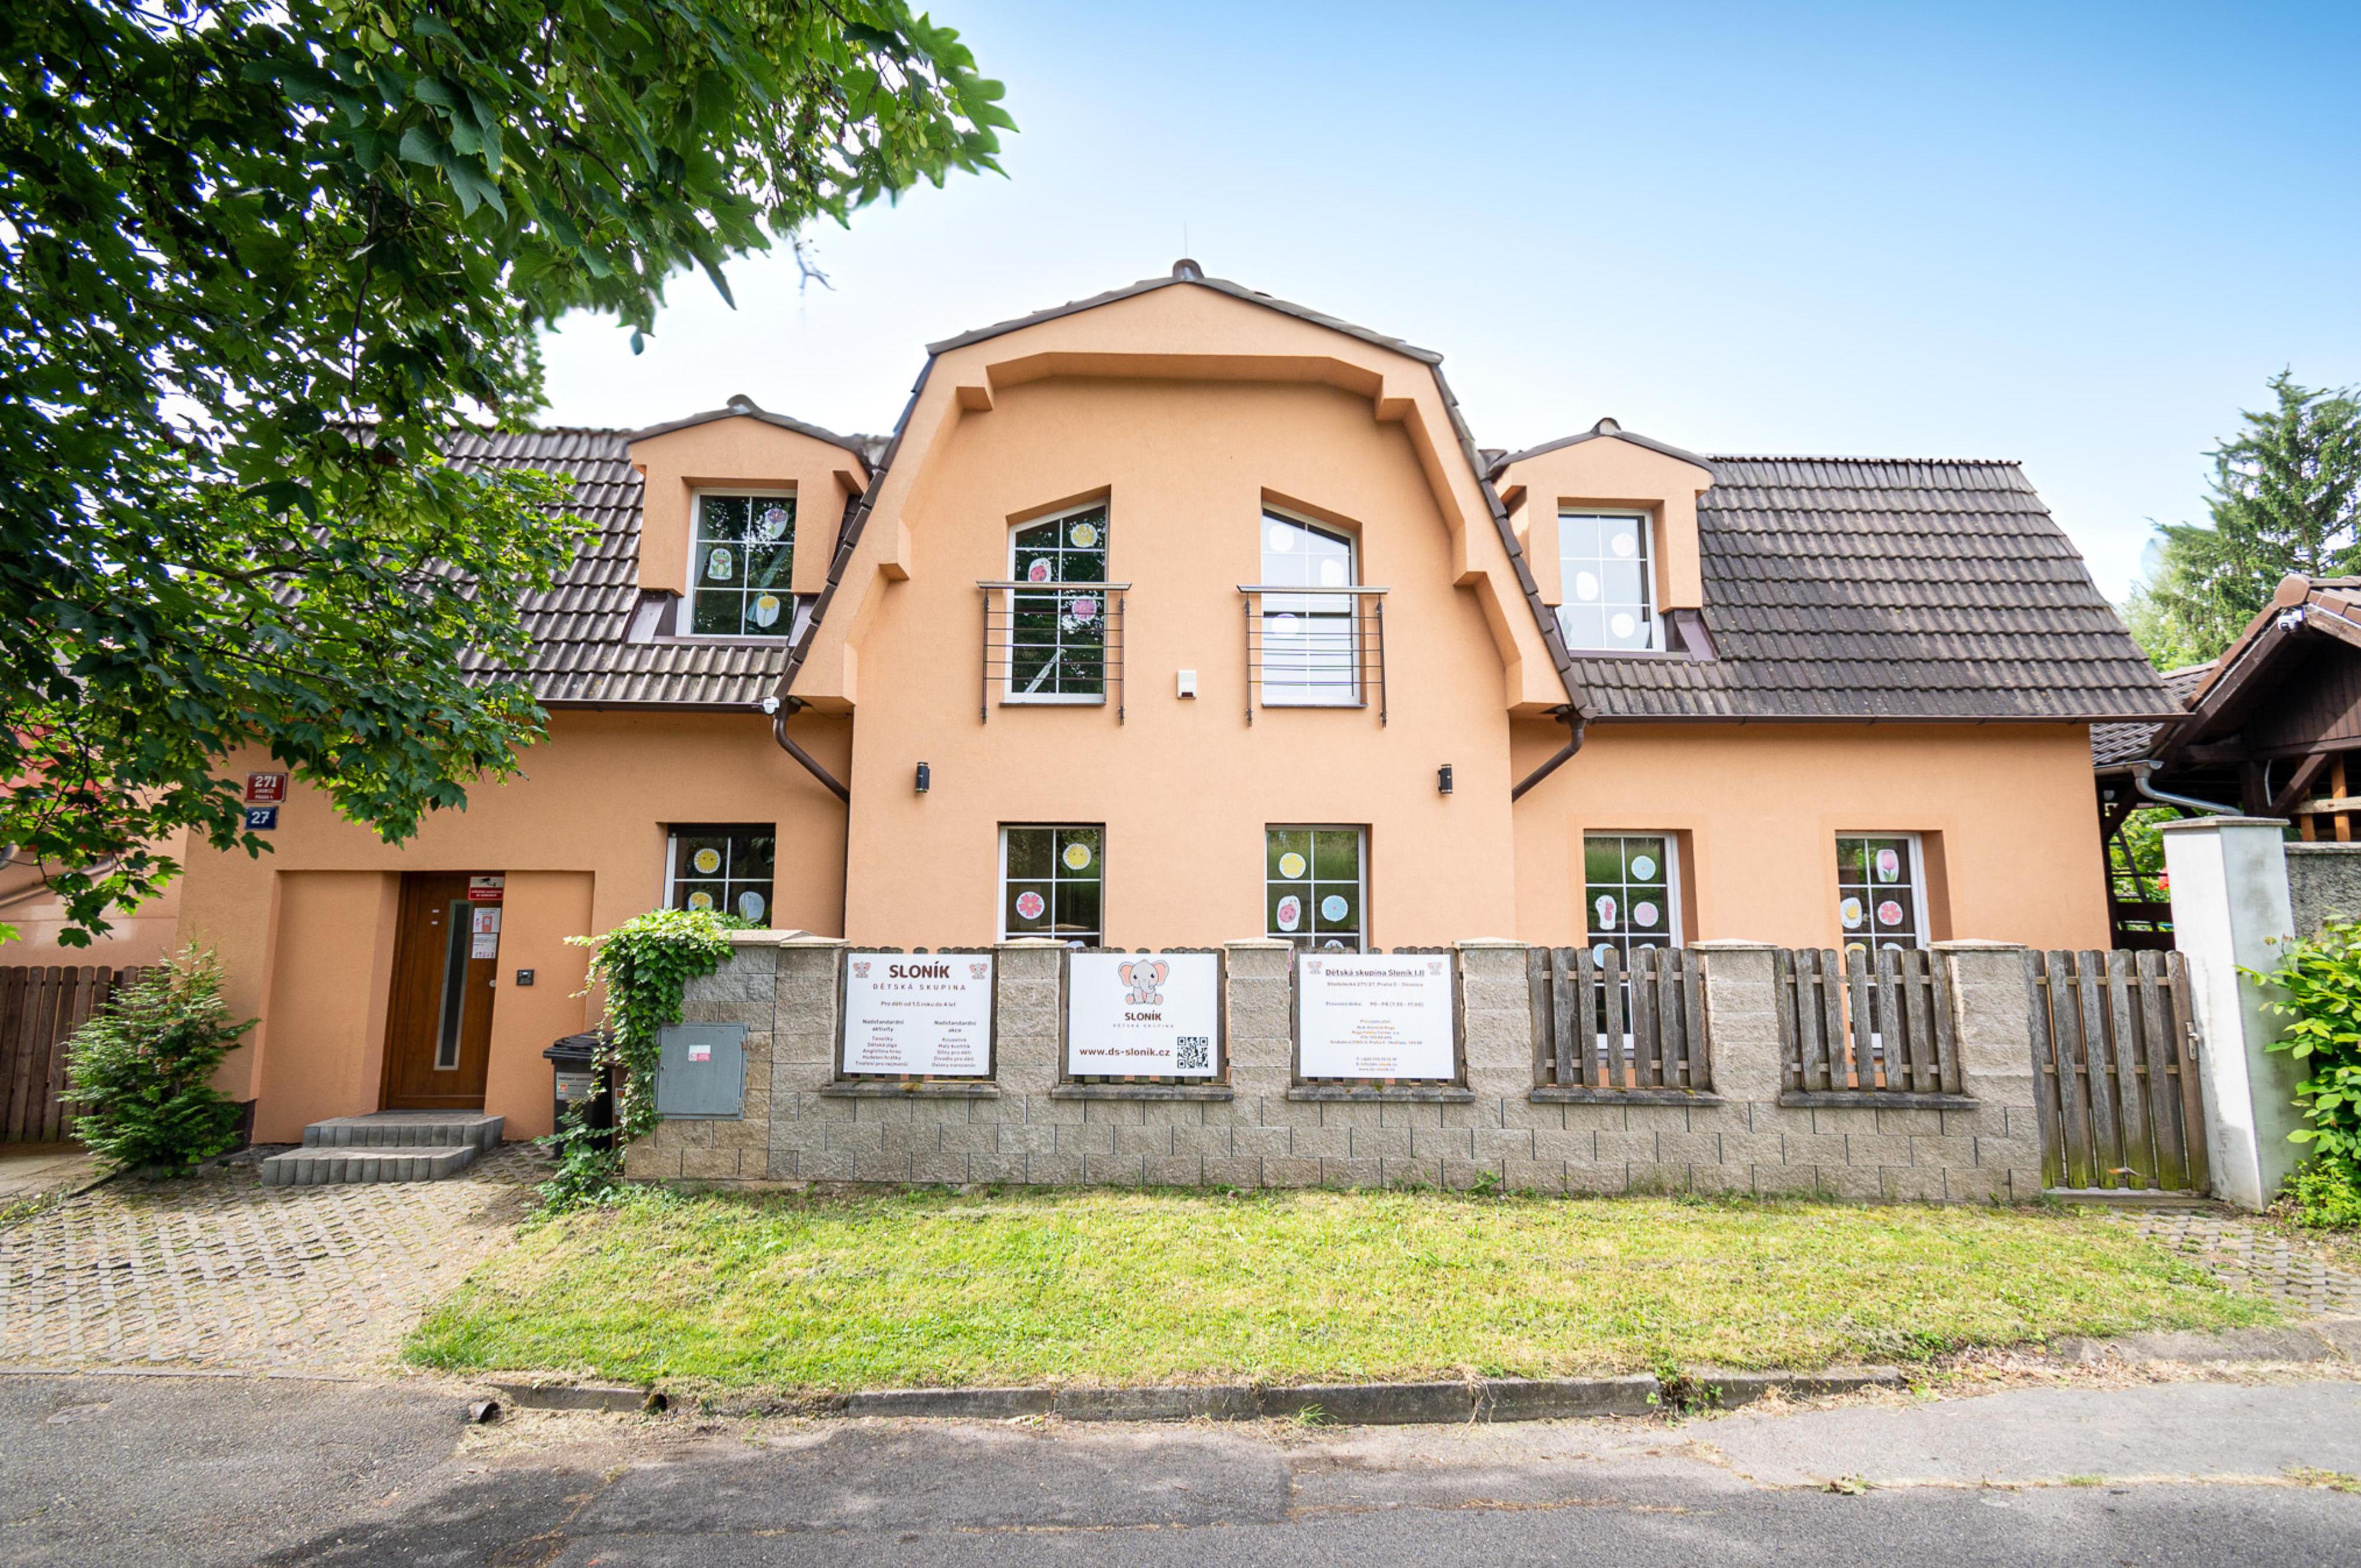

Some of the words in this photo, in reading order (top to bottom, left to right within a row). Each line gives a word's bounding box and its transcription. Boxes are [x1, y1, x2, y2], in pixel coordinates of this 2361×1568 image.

[254, 775, 277, 787] 271
[251, 811, 270, 824] 27
[889, 961, 950, 978] SLONÍK
[1355, 969, 1386, 977] skupina
[1124, 1010, 1162, 1021] SLONÍK
[1079, 1047, 1170, 1057] www.ds-slonik.cz
